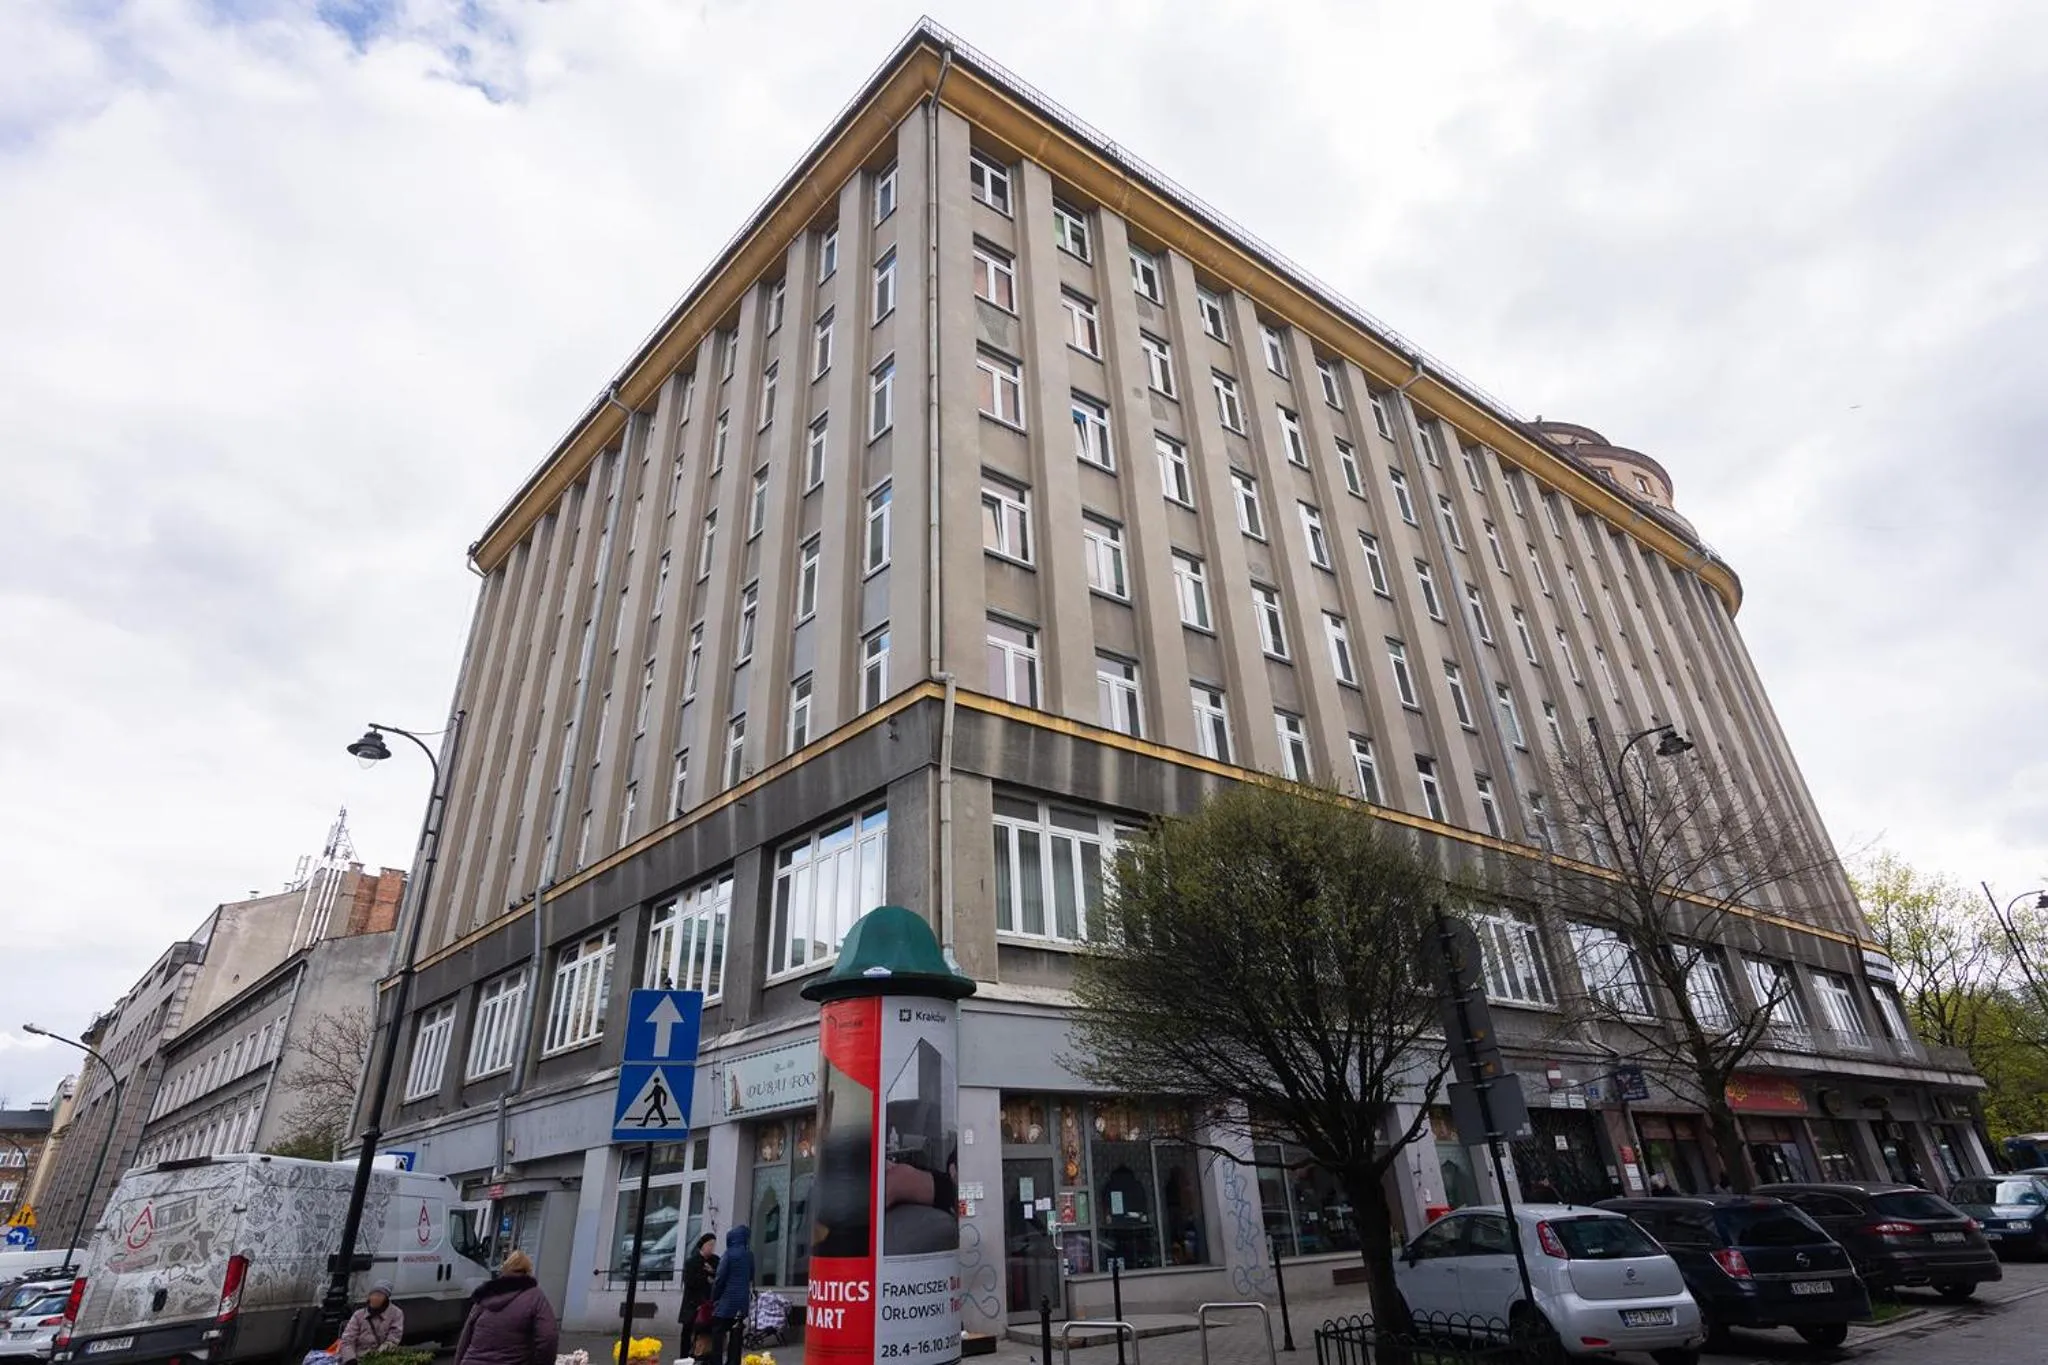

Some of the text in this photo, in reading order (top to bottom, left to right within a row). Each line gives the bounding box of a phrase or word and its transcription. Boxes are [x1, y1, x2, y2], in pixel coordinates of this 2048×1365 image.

[915, 1011, 947, 1024] Kraków
[747, 1077, 786, 1097] DUBAI
[882, 1279, 949, 1298] FRANCISZEK
[816, 1307, 846, 1329] ART
[881, 1302, 945, 1321] ORŁOWSKI
